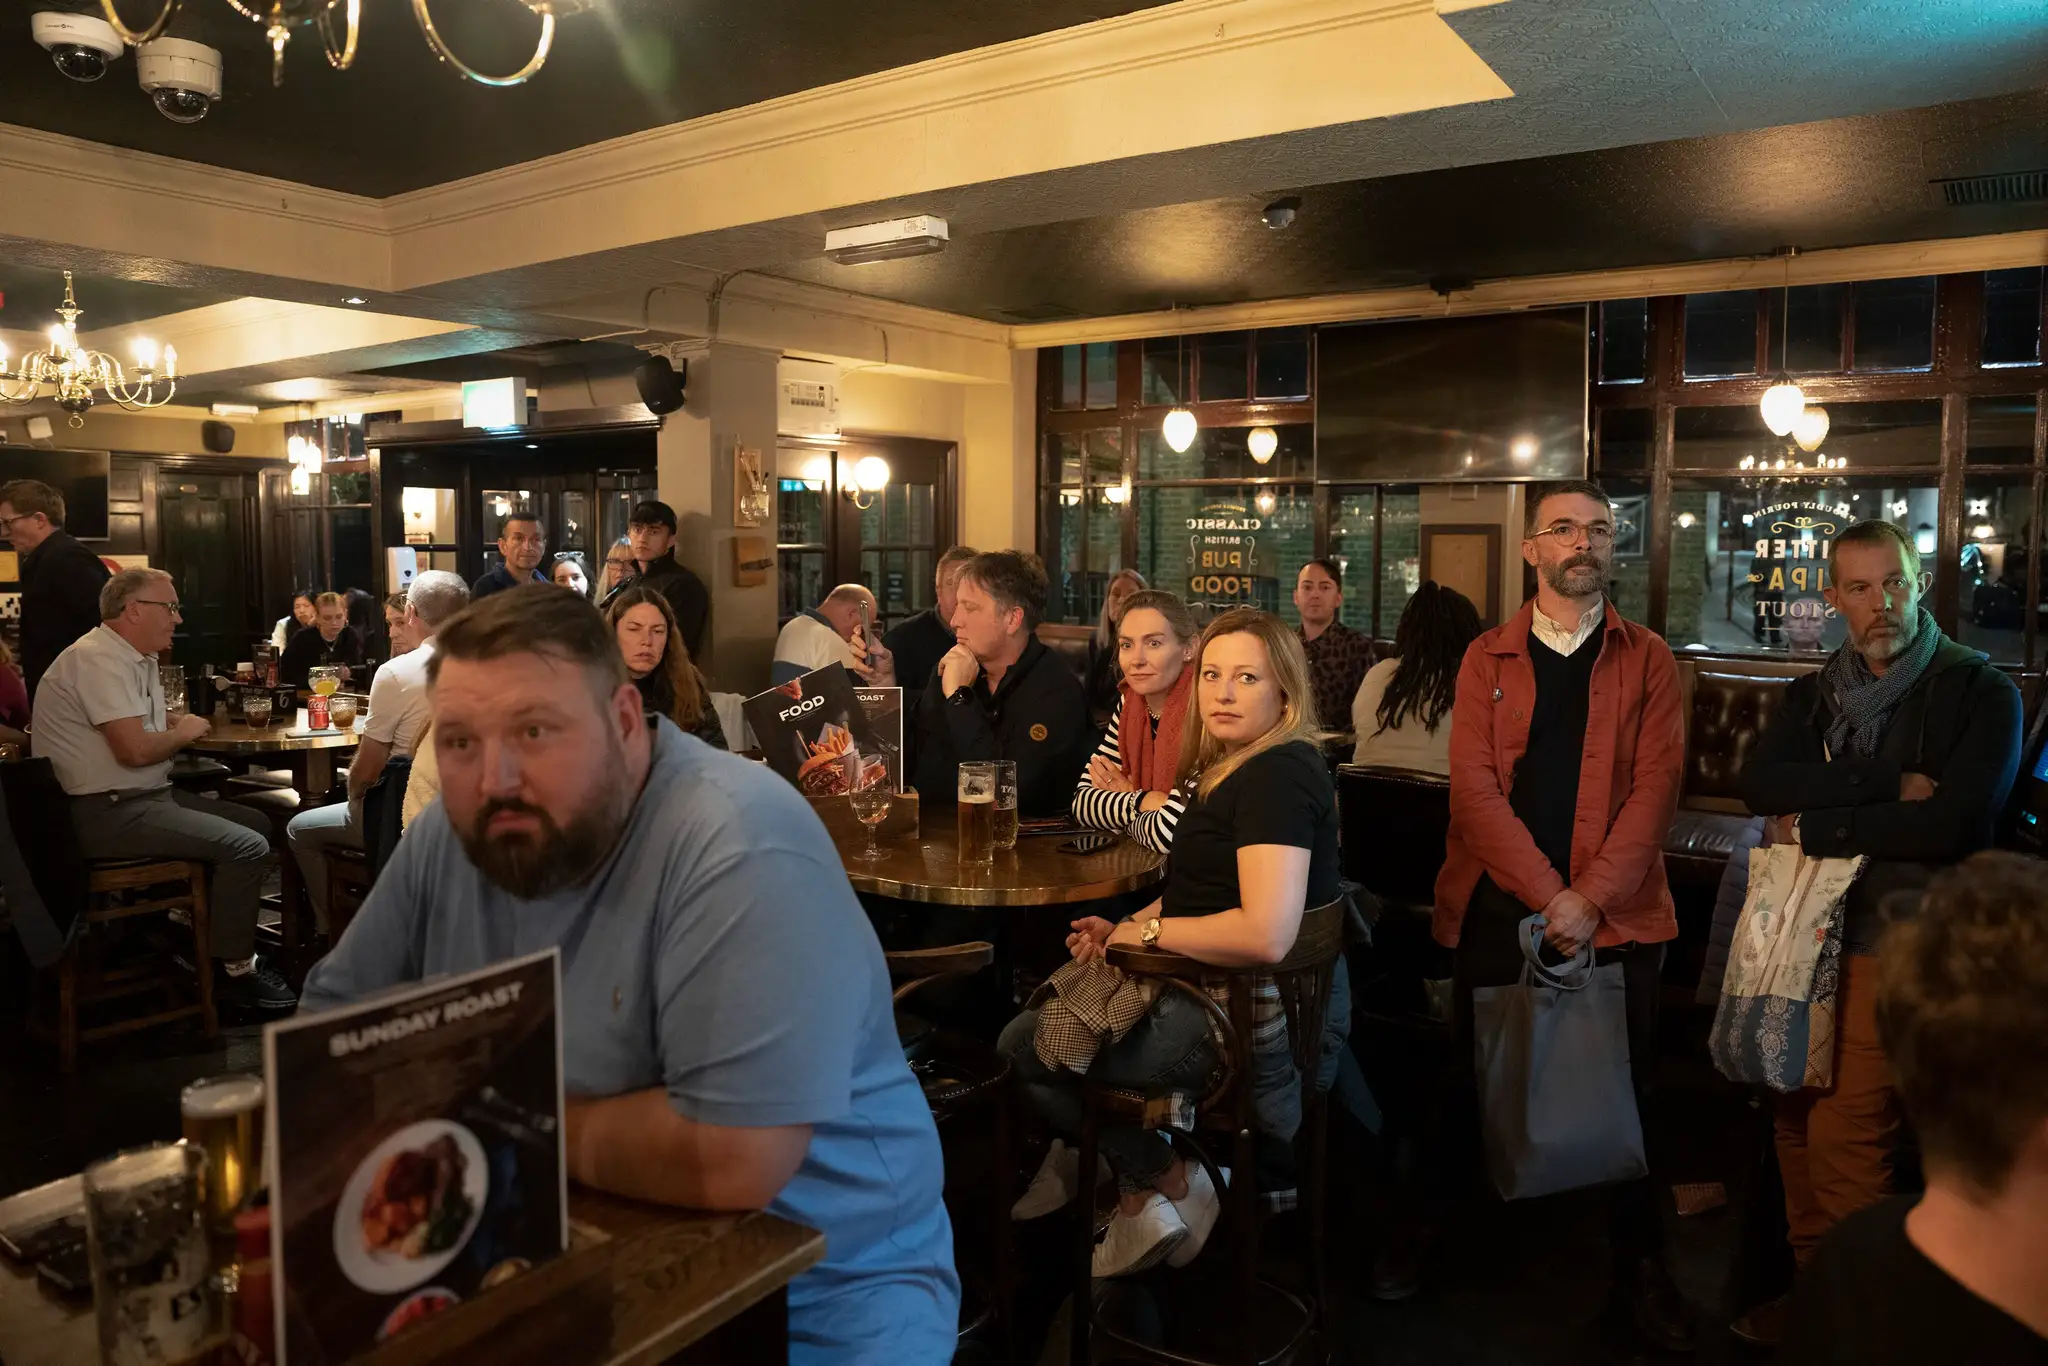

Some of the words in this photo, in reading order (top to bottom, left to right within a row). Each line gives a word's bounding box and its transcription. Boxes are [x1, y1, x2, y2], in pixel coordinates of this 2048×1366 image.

[779, 695, 825, 722] FOOD
[329, 1007, 441, 1057] SUNDAY
[443, 982, 524, 1023] ROAST
